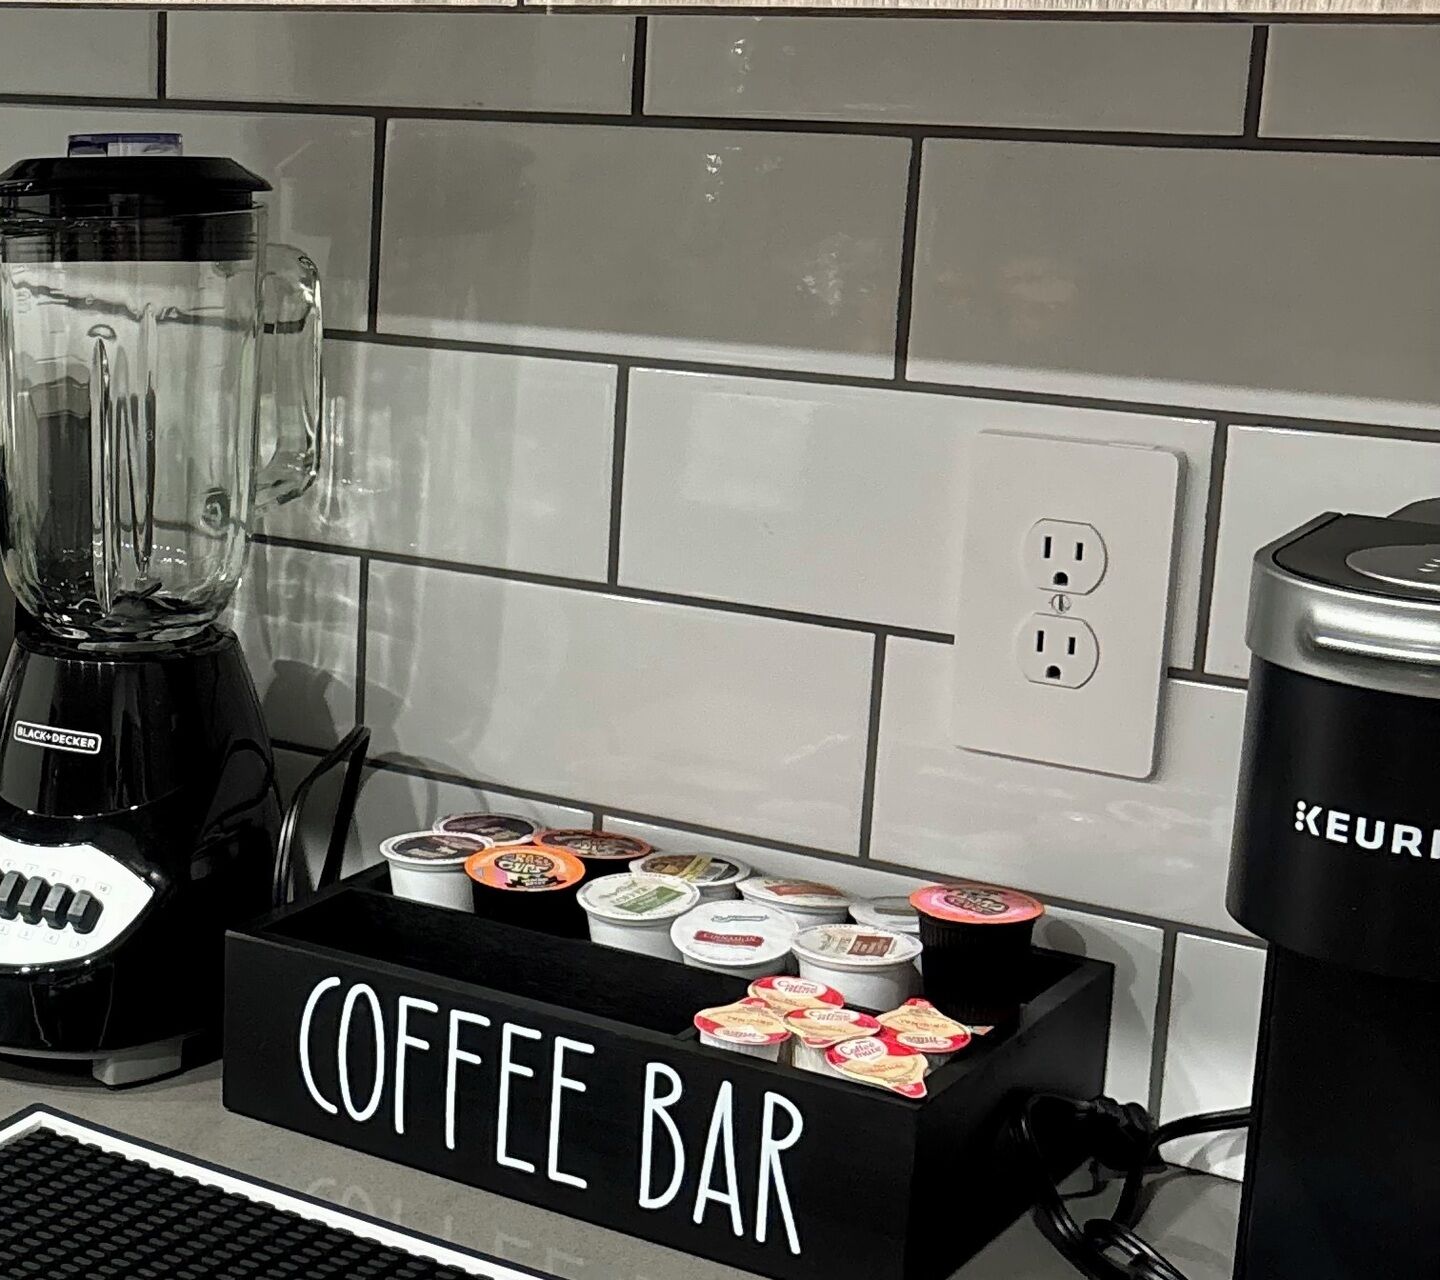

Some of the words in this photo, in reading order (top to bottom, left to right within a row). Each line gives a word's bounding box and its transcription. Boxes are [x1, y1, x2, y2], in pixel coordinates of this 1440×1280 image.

[17, 725, 96, 749] BLACK+DECKER
[298, 975, 597, 1190] COFFEE
[638, 1061, 805, 1257] BAR
